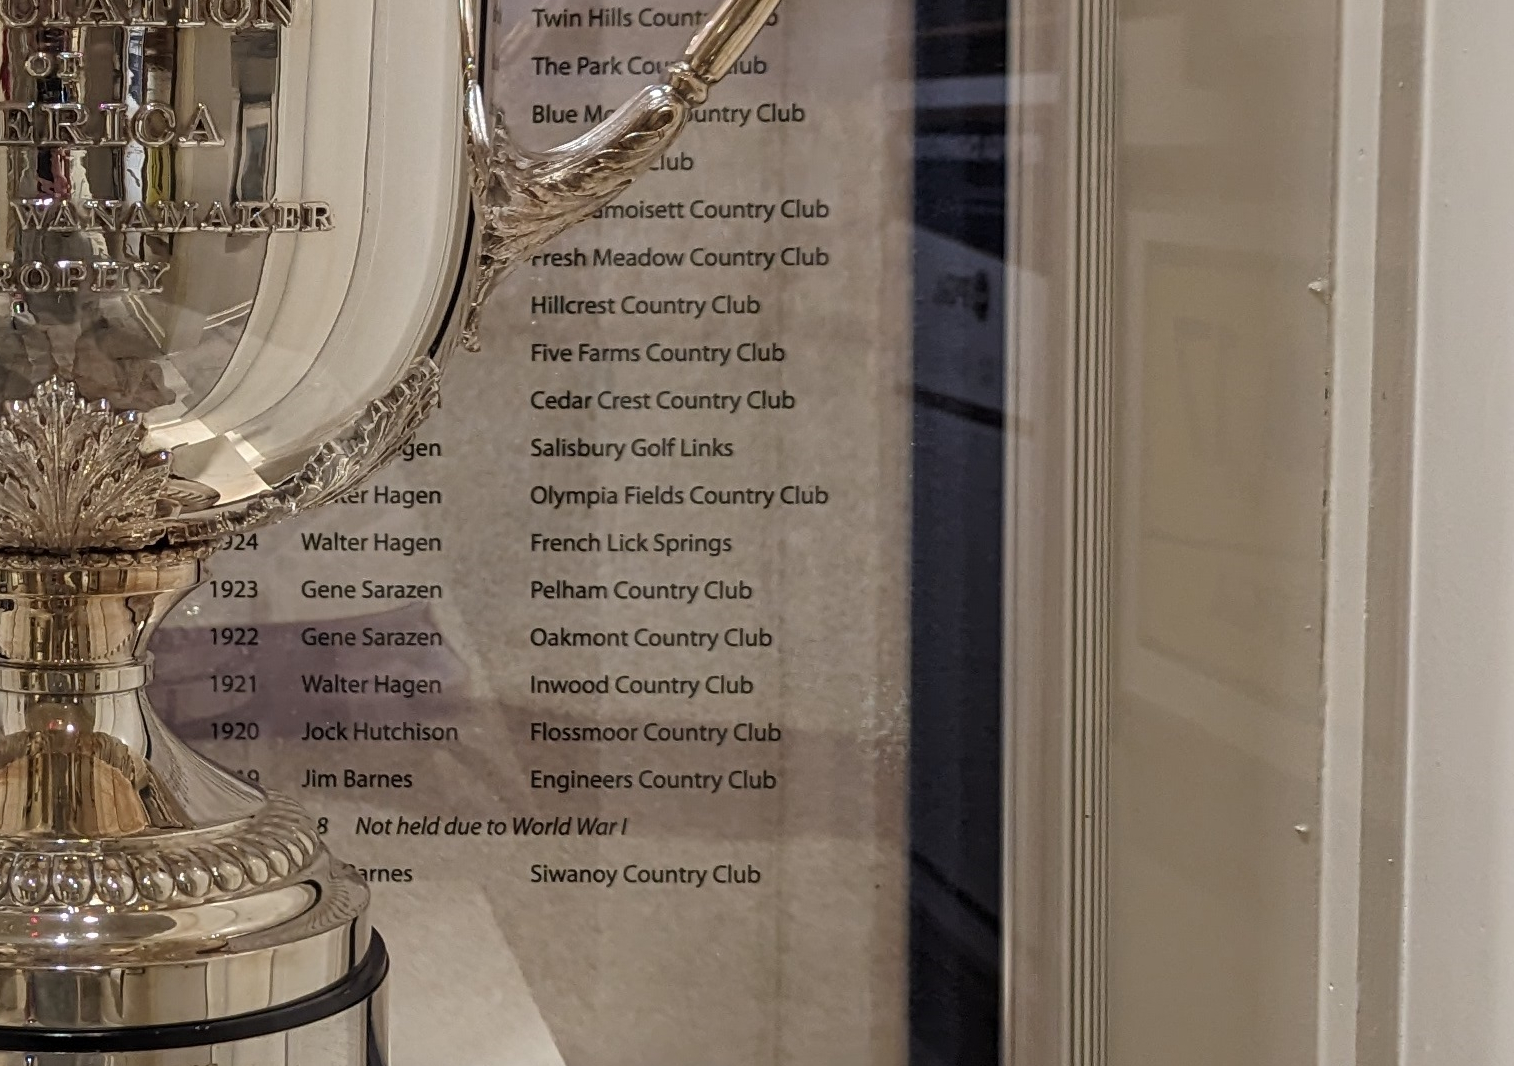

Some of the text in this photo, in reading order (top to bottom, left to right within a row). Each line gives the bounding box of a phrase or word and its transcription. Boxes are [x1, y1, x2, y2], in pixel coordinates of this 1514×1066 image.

[24, 52, 83, 78] OF
[11, 199, 336, 232] WANAMAKER
[530, 294, 762, 320] Hillcrest Country Club
[530, 342, 786, 367] Five Farms Country Club
[209, 579, 754, 605] 1923 Gene Sarazen Pelham Country Club
[210, 673, 755, 700] 1921 Walter Hagen Inwood Country Club
[211, 721, 782, 747] 1920 Jock Hutchison Flossmoor Country Club
[355, 815, 628, 836] Not held due to World War I
